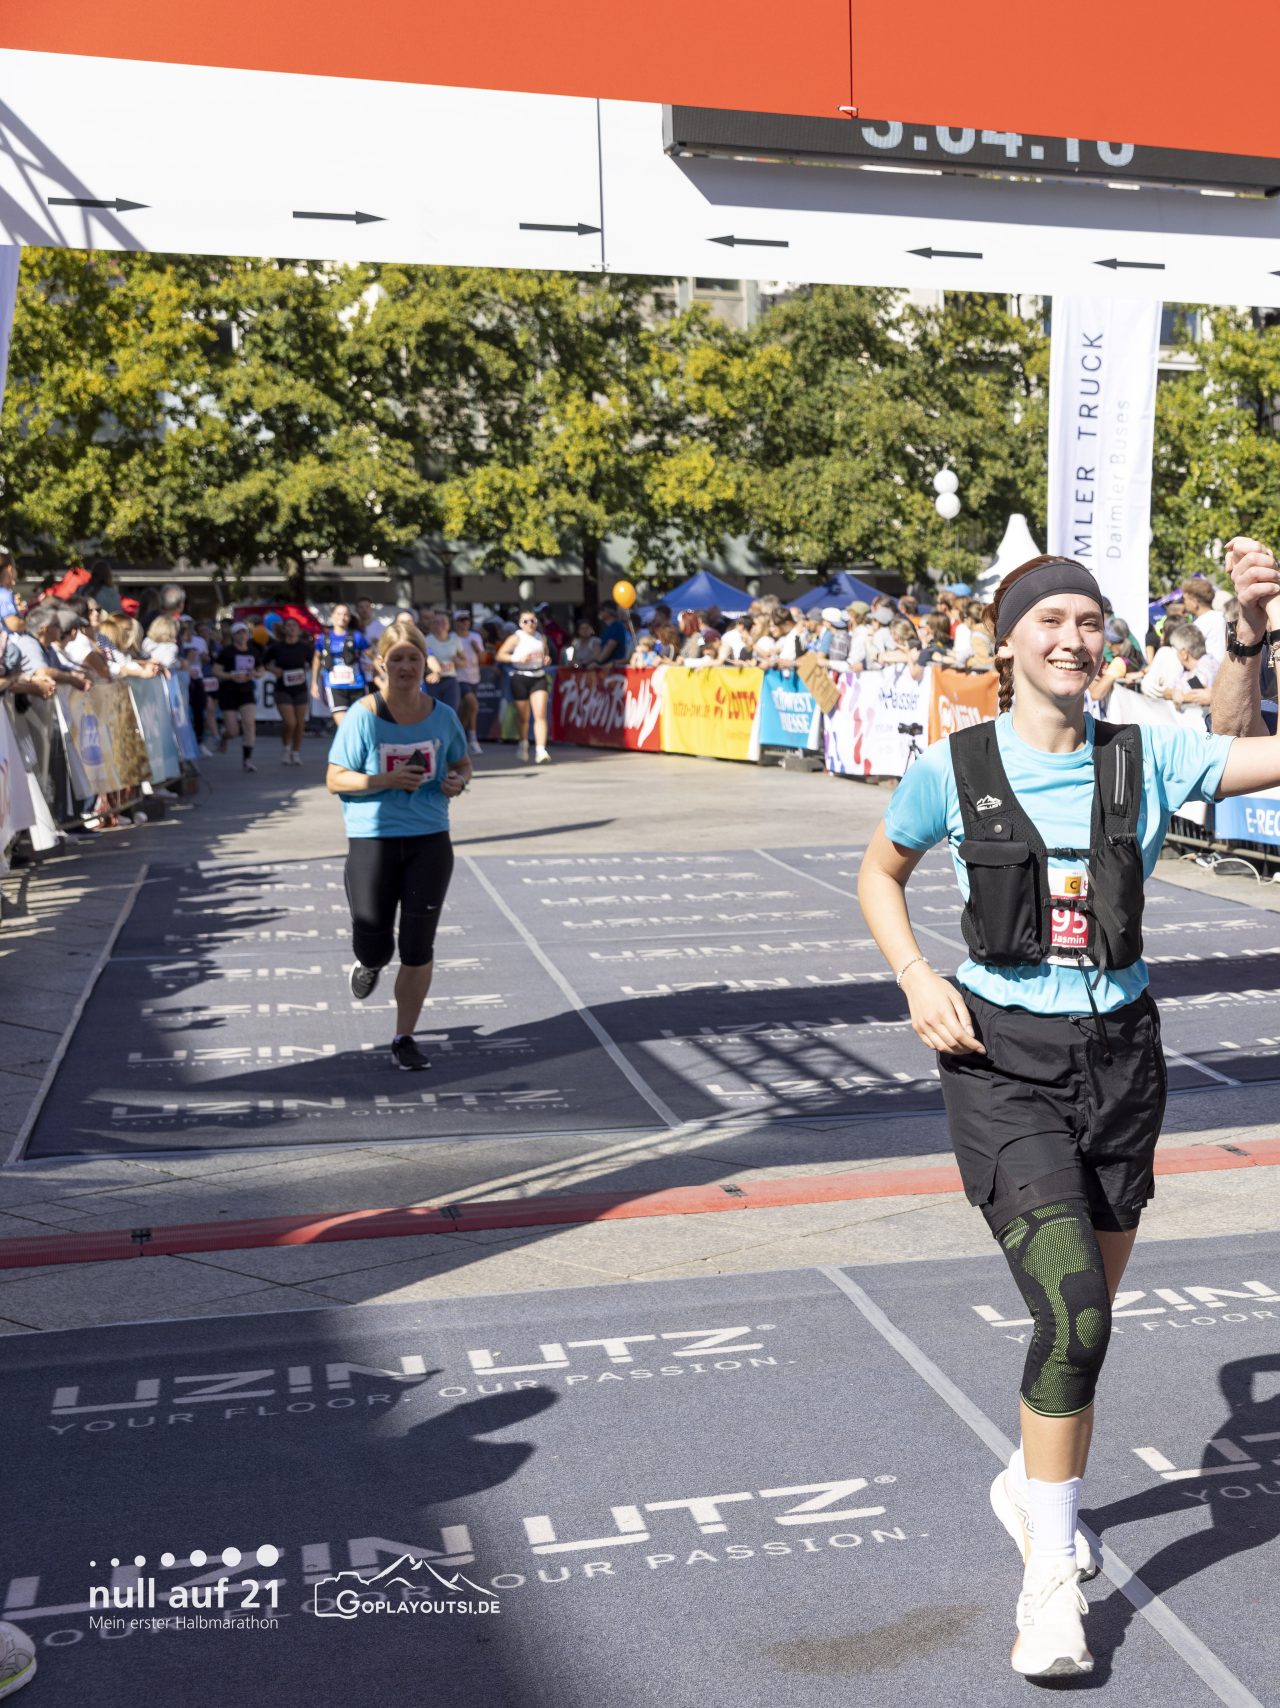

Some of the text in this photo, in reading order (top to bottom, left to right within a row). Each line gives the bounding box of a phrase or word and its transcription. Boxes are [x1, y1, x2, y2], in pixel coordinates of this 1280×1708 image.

[1078, 332, 1103, 440] TRUCK
[1106, 400, 1130, 559] Daimler Buses
[1053, 933, 1085, 944] Jasmin
[47, 1355, 799, 1436] YOUR FLOOR. OUR PASSION.
[490, 1560, 616, 1590] OUR
[645, 1525, 930, 1571] PASSION.
